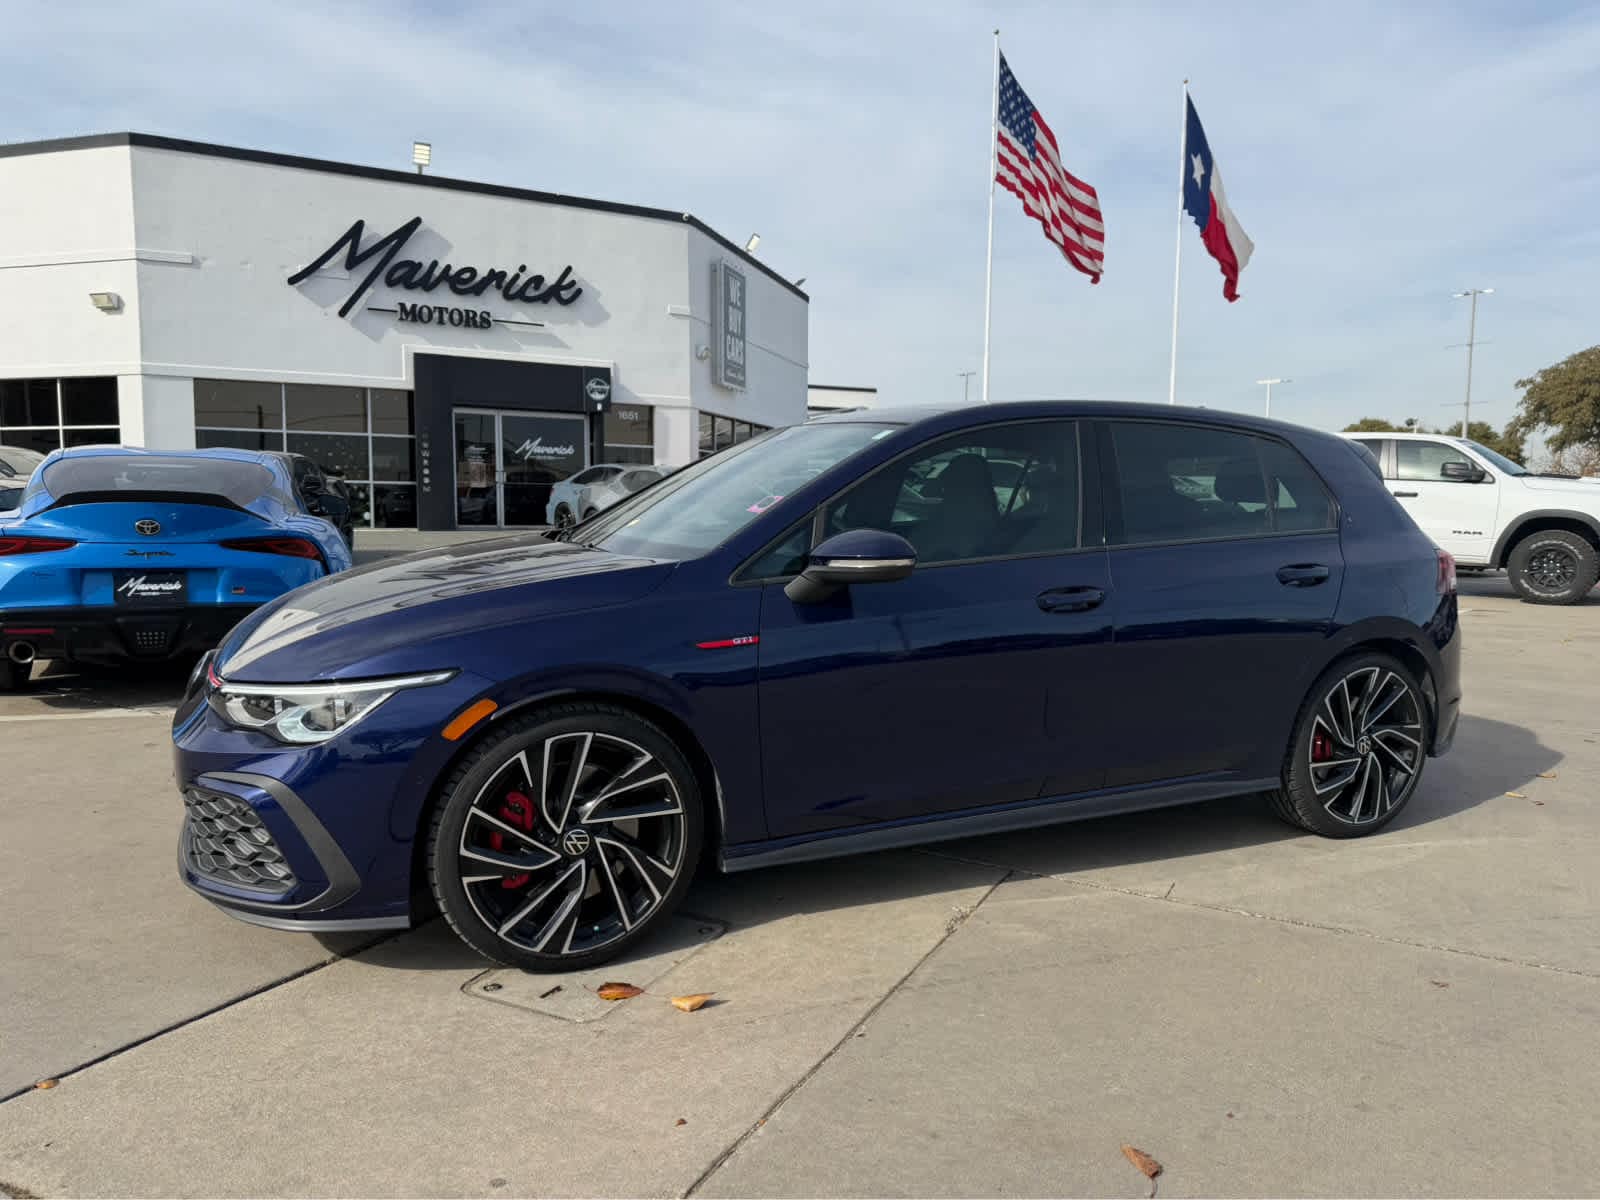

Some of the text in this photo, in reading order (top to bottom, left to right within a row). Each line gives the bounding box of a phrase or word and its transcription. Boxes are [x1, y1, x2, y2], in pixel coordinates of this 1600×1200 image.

[287, 216, 583, 318] Maverick
[397, 302, 493, 330] MOTORS
[515, 437, 575, 460] Maverick
[732, 636, 753, 645] GTI
